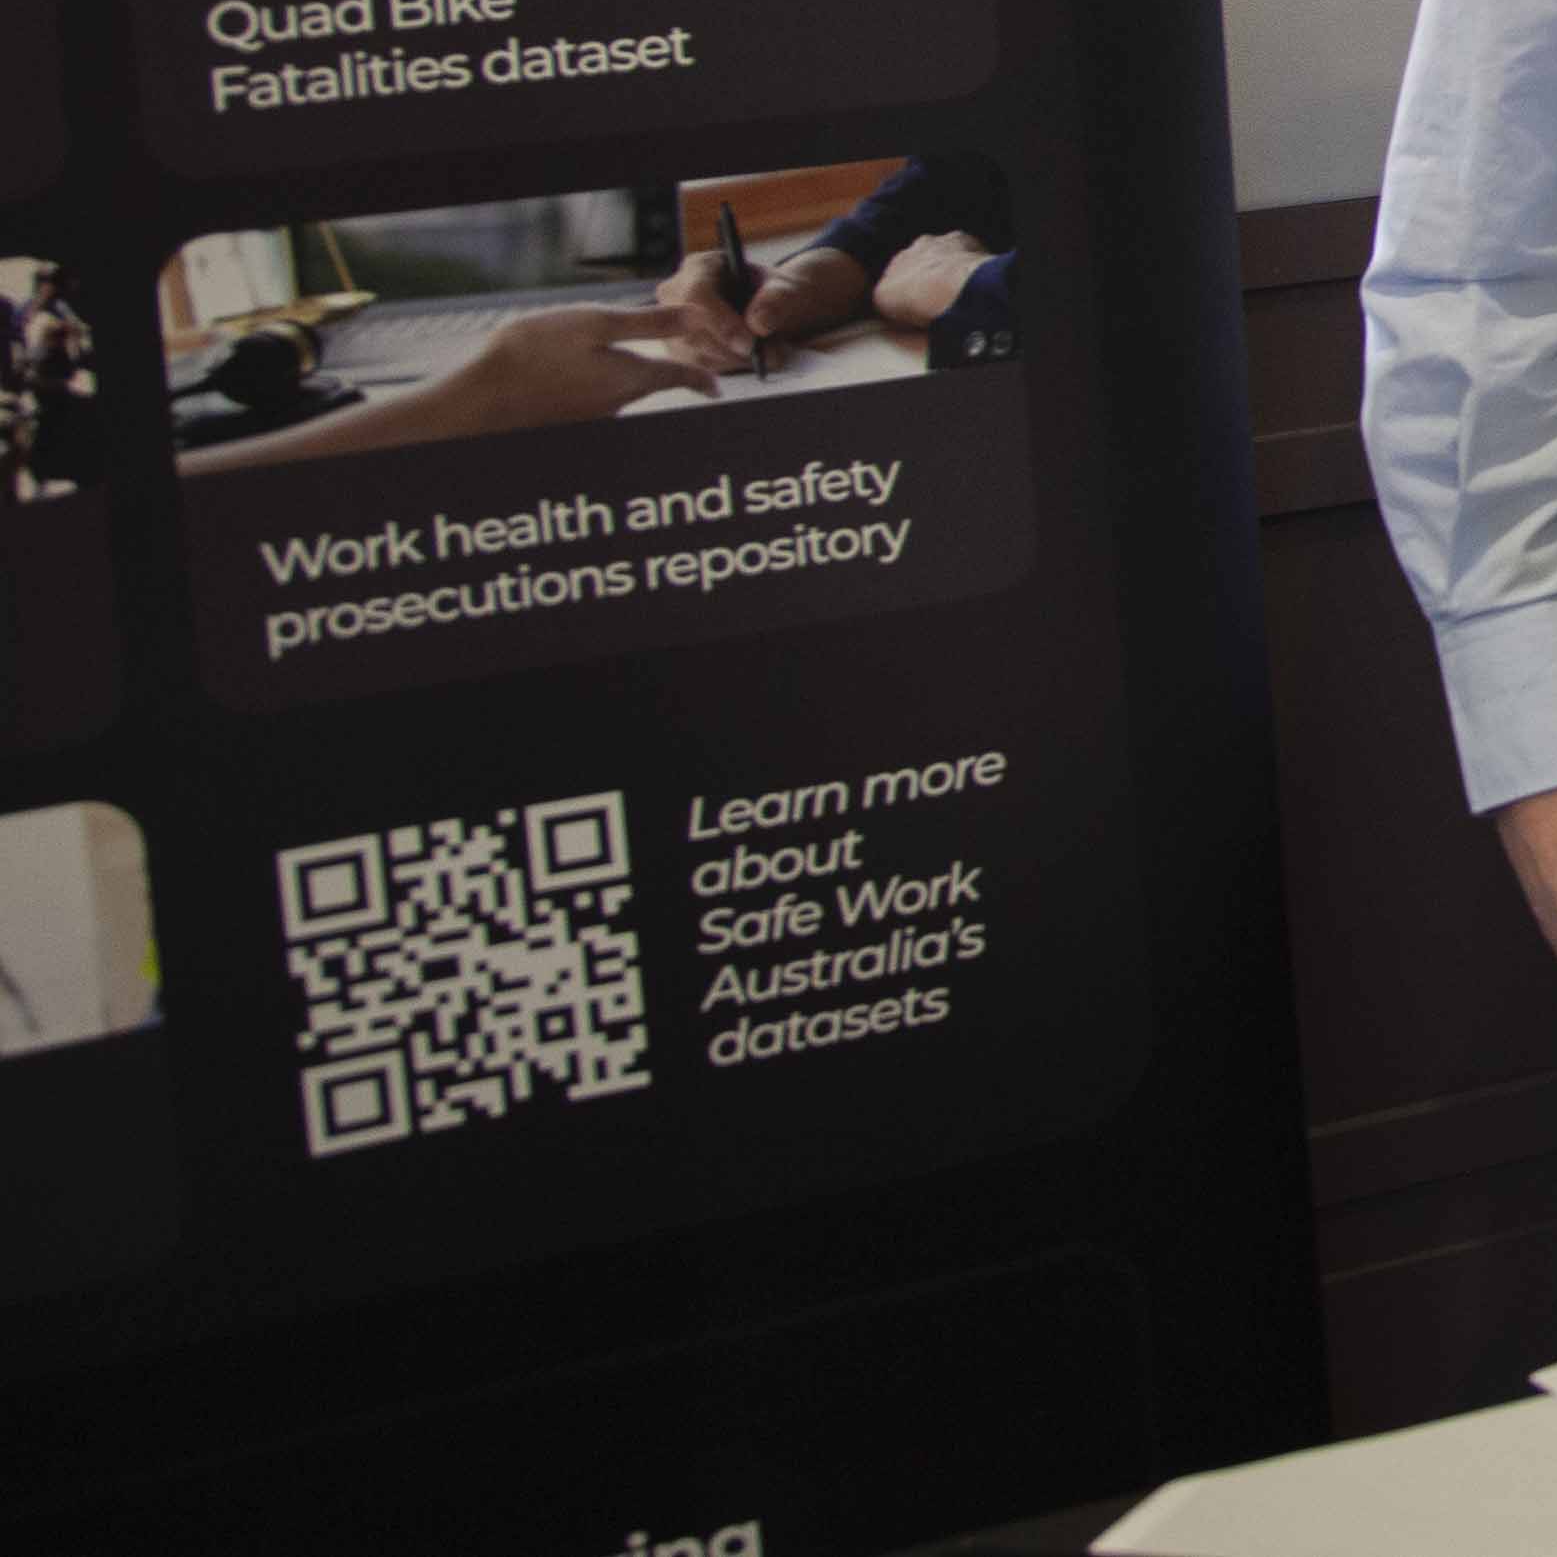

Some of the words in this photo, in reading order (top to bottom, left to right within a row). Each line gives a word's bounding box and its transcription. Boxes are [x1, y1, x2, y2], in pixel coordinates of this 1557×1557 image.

[213, 48, 472, 111] Fatalities
[483, 28, 694, 83] dataset
[262, 523, 424, 582] Work
[435, 495, 613, 557] health
[627, 475, 732, 530] and
[744, 461, 901, 513] safety
[268, 562, 635, 657] prosecutions
[643, 516, 910, 591] repository
[690, 782, 848, 839] Learn
[863, 753, 1005, 807] more
[693, 831, 862, 895] about
[699, 894, 822, 952] Safe
[837, 861, 980, 925] Work
[702, 918, 985, 1011] Australia's
[707, 983, 949, 1066] datasets
